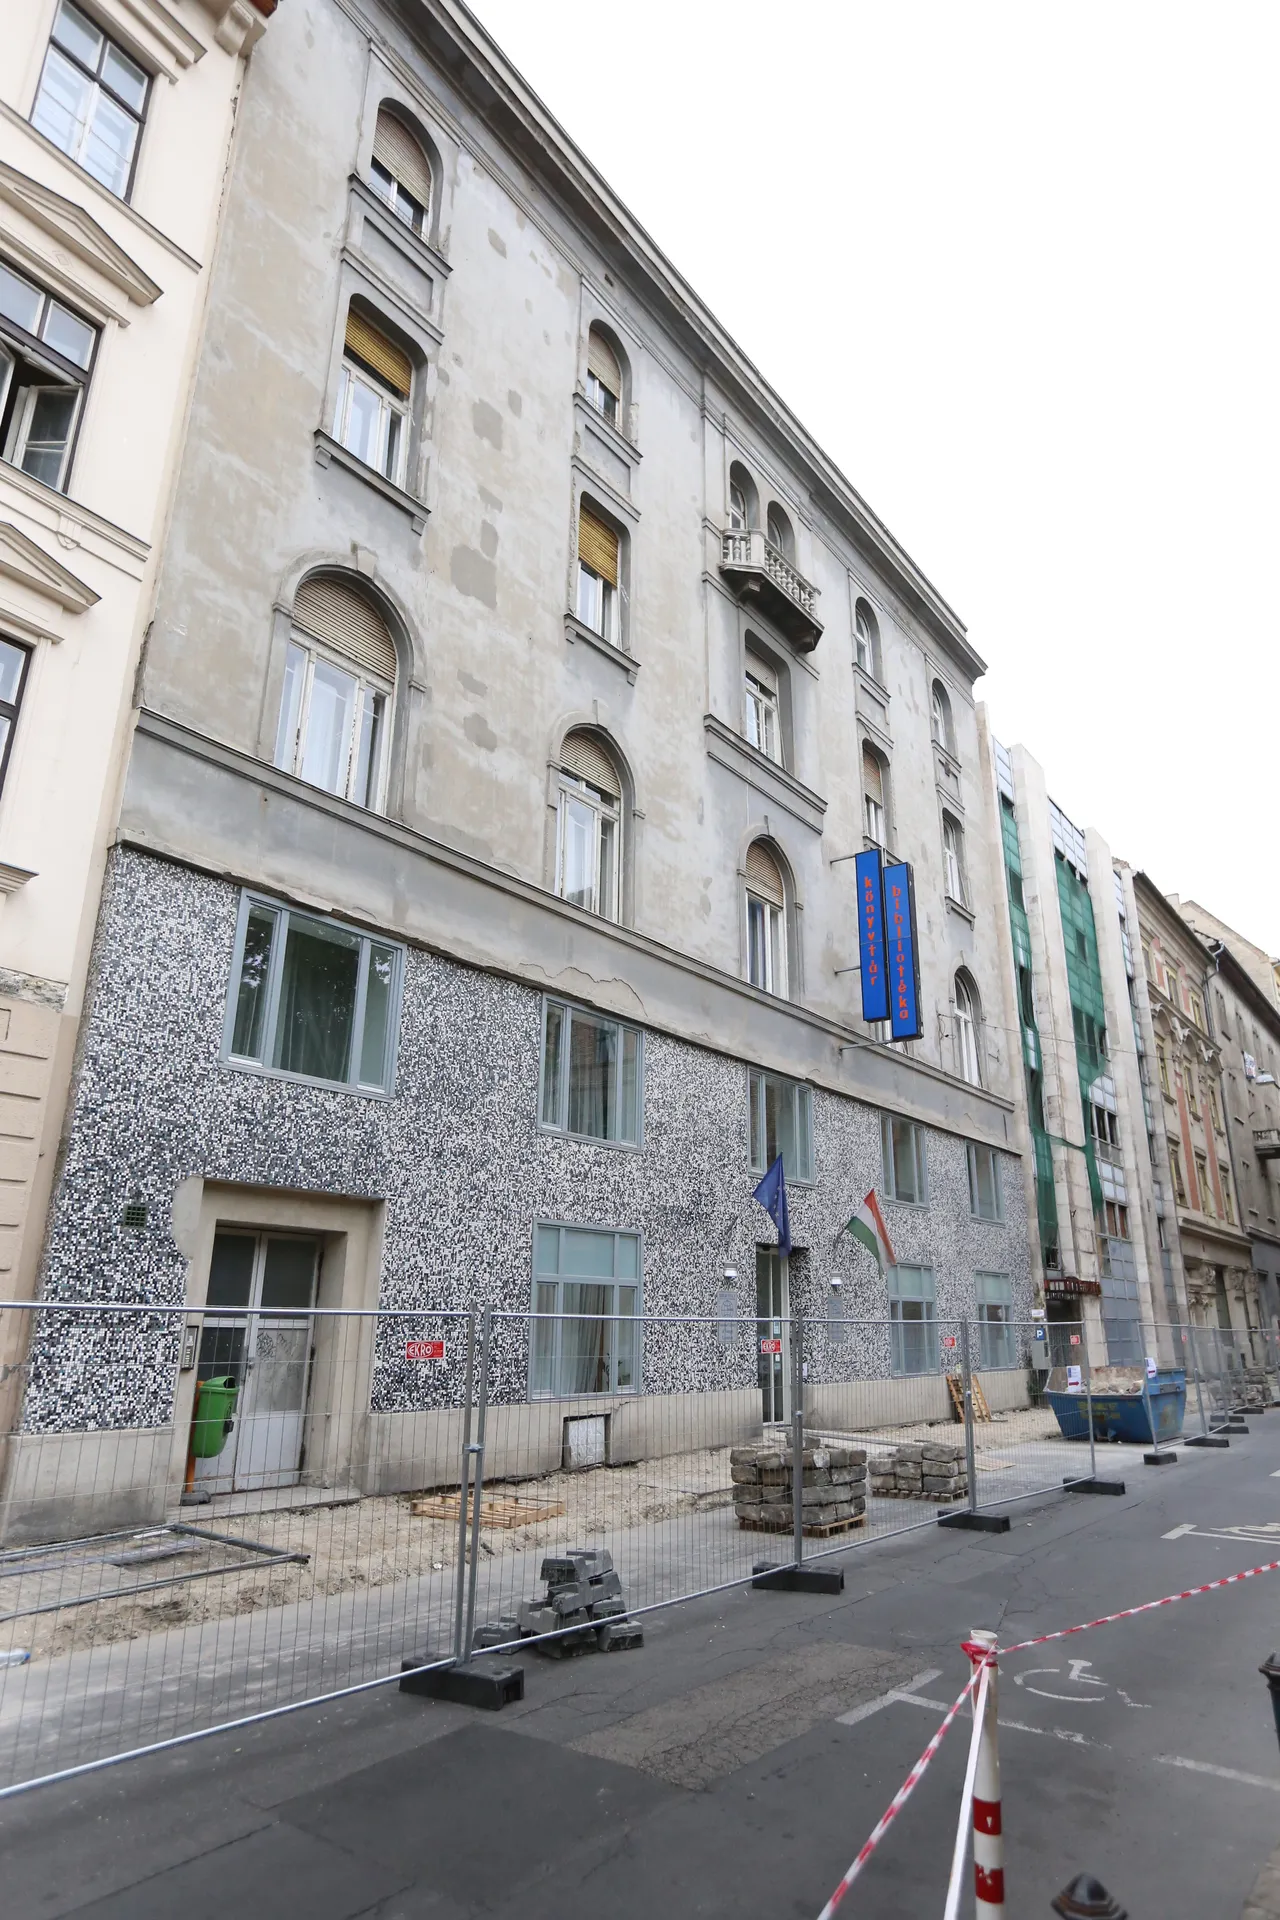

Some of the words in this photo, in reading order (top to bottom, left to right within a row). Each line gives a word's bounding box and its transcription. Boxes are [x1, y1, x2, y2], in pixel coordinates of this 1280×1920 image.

[864, 876, 878, 986] könyvtár
[892, 885, 909, 1020] bibliotéka
[409, 1343, 432, 1356] EKRO
[1036, 1330, 1043, 1338] P
